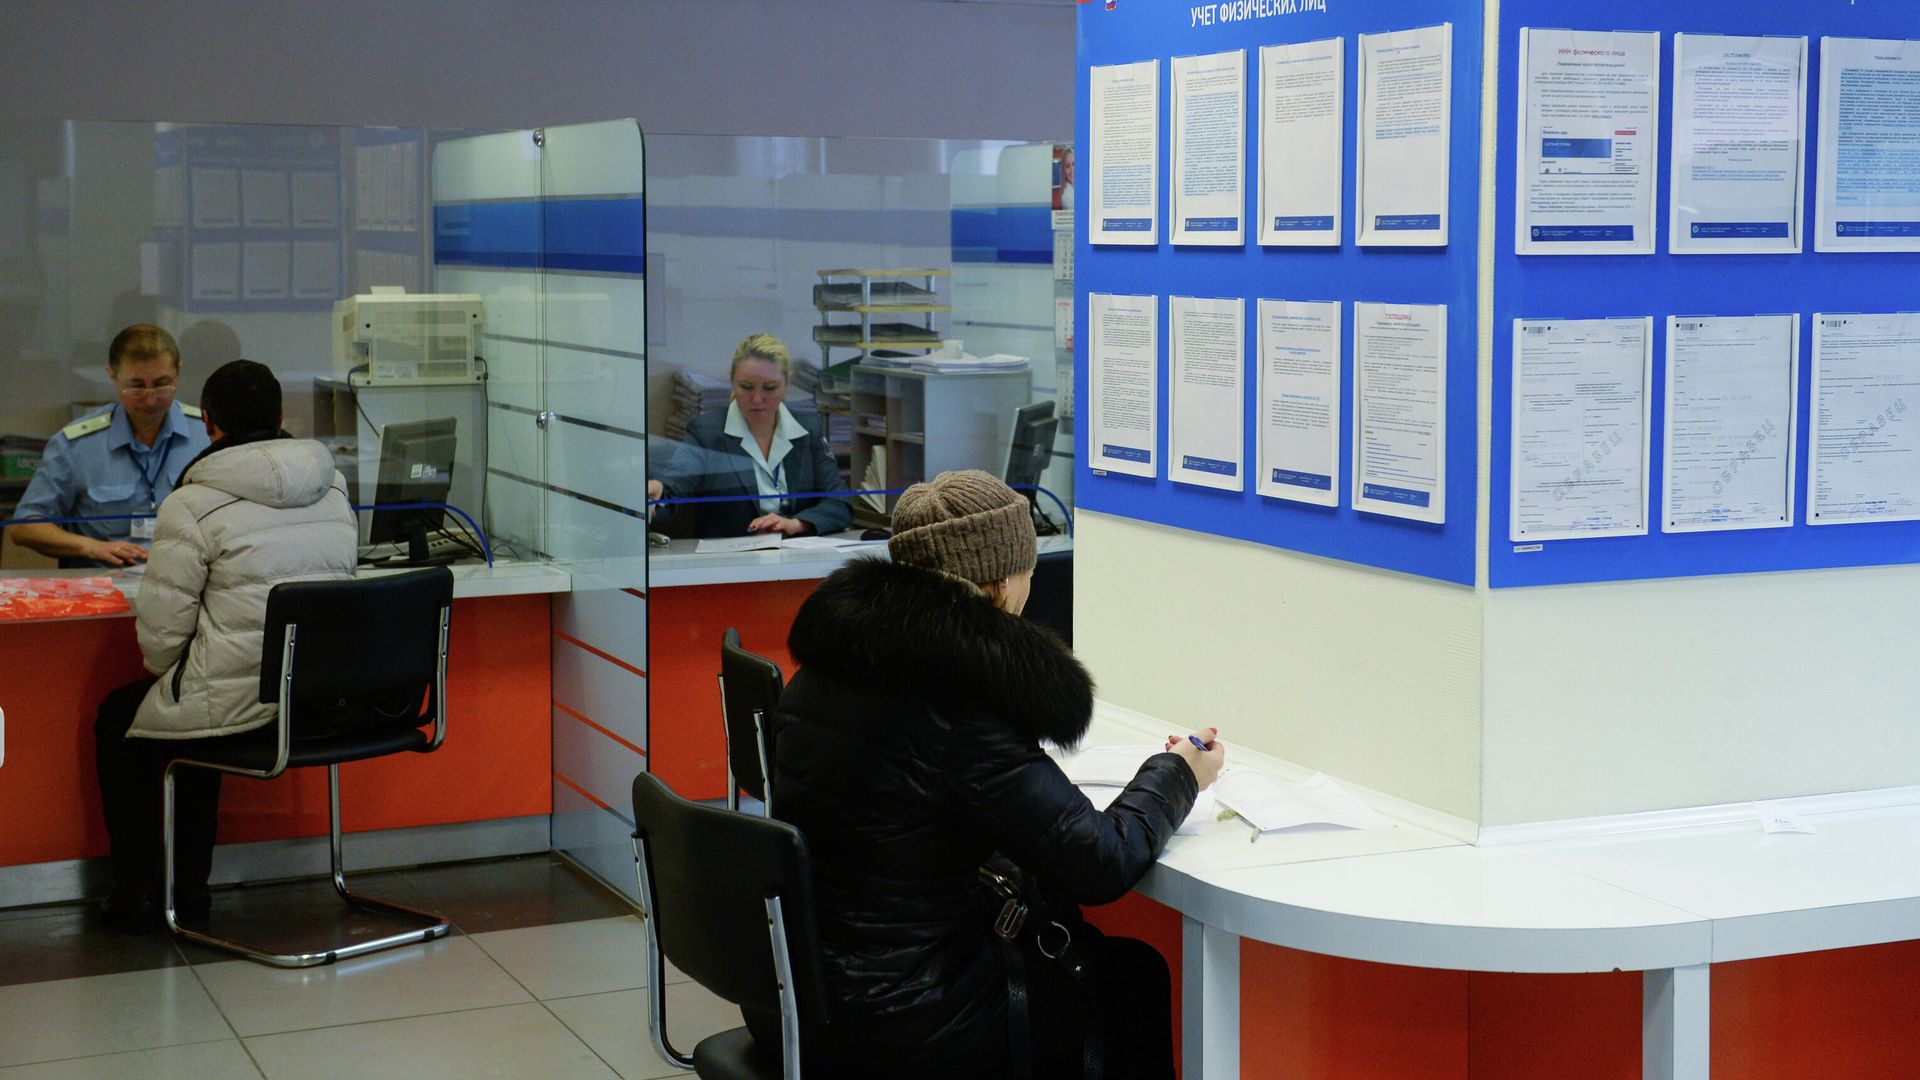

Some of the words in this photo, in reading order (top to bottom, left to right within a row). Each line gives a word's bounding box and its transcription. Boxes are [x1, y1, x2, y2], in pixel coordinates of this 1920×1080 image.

[1191, 4, 1217, 27] УЧЕТ
[1220, 0, 1297, 23] ФИЗИЧЕСКИХ
[1712, 419, 1776, 495] ОБРАЗЕЦ
